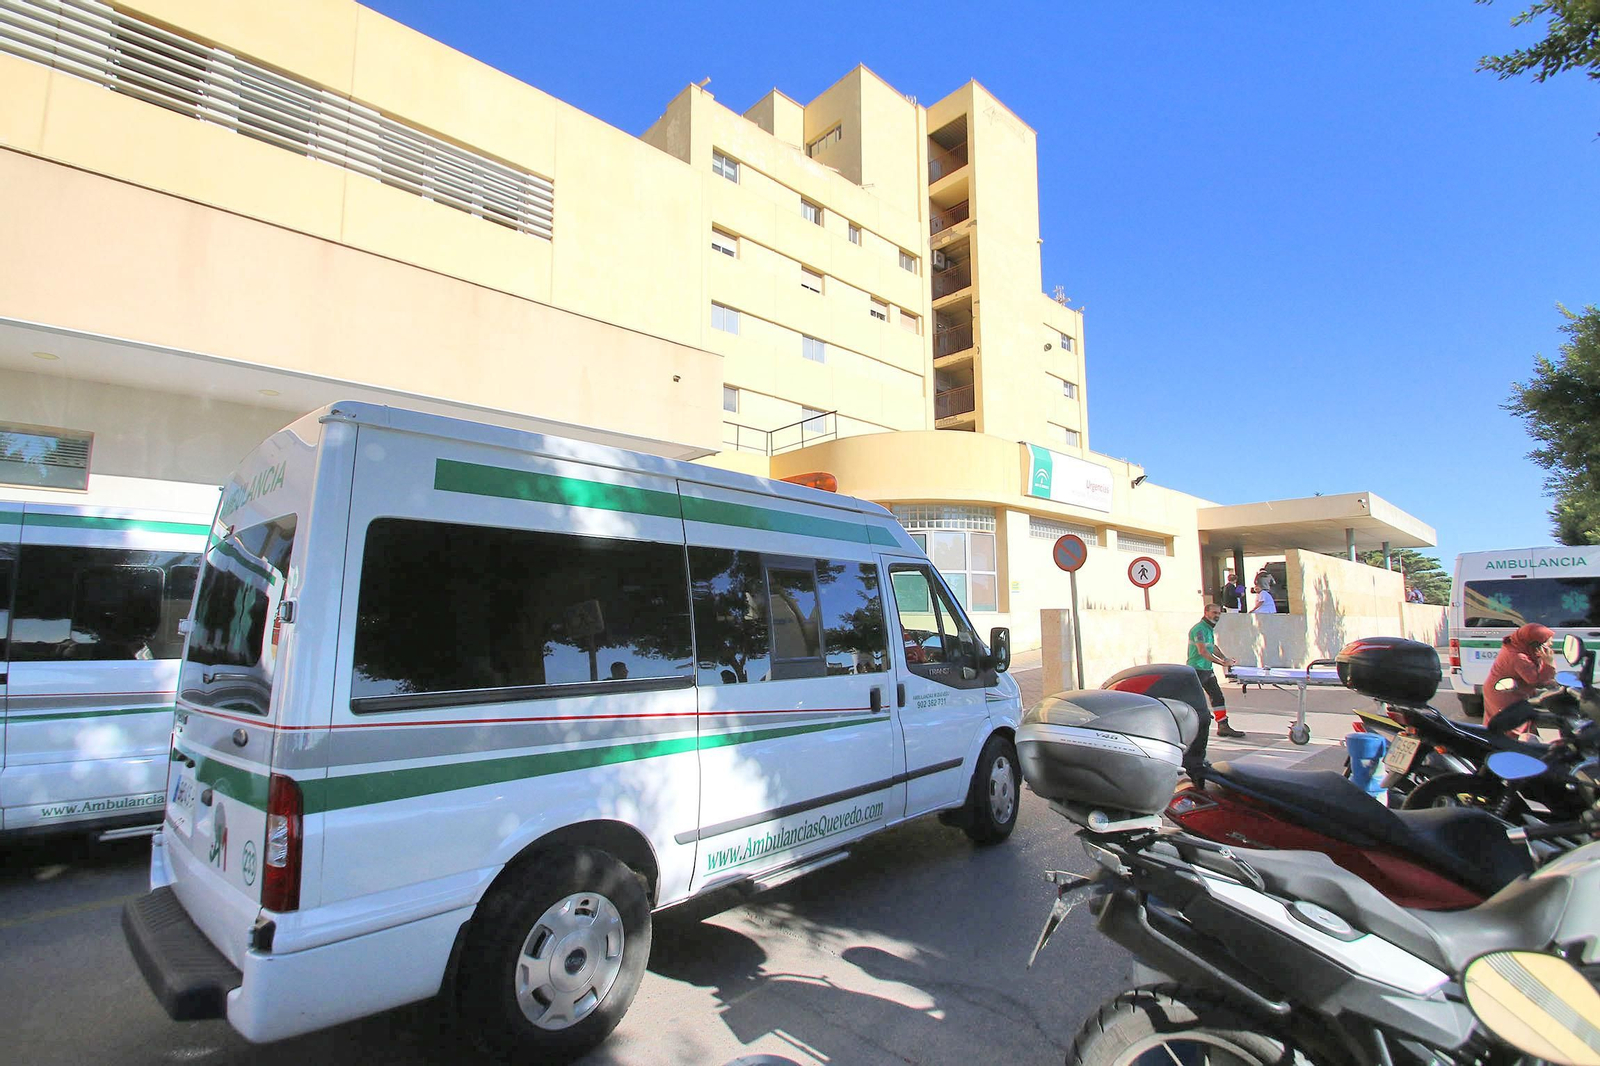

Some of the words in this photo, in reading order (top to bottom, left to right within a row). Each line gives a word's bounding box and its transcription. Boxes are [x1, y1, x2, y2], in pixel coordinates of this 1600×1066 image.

[1086, 479, 1110, 494] Urgencias
[1485, 556, 1588, 570] AMBULANCIA
[917, 700, 927, 709] 902
[707, 801, 884, 870] www.AmbulanciasQuevedo.com
